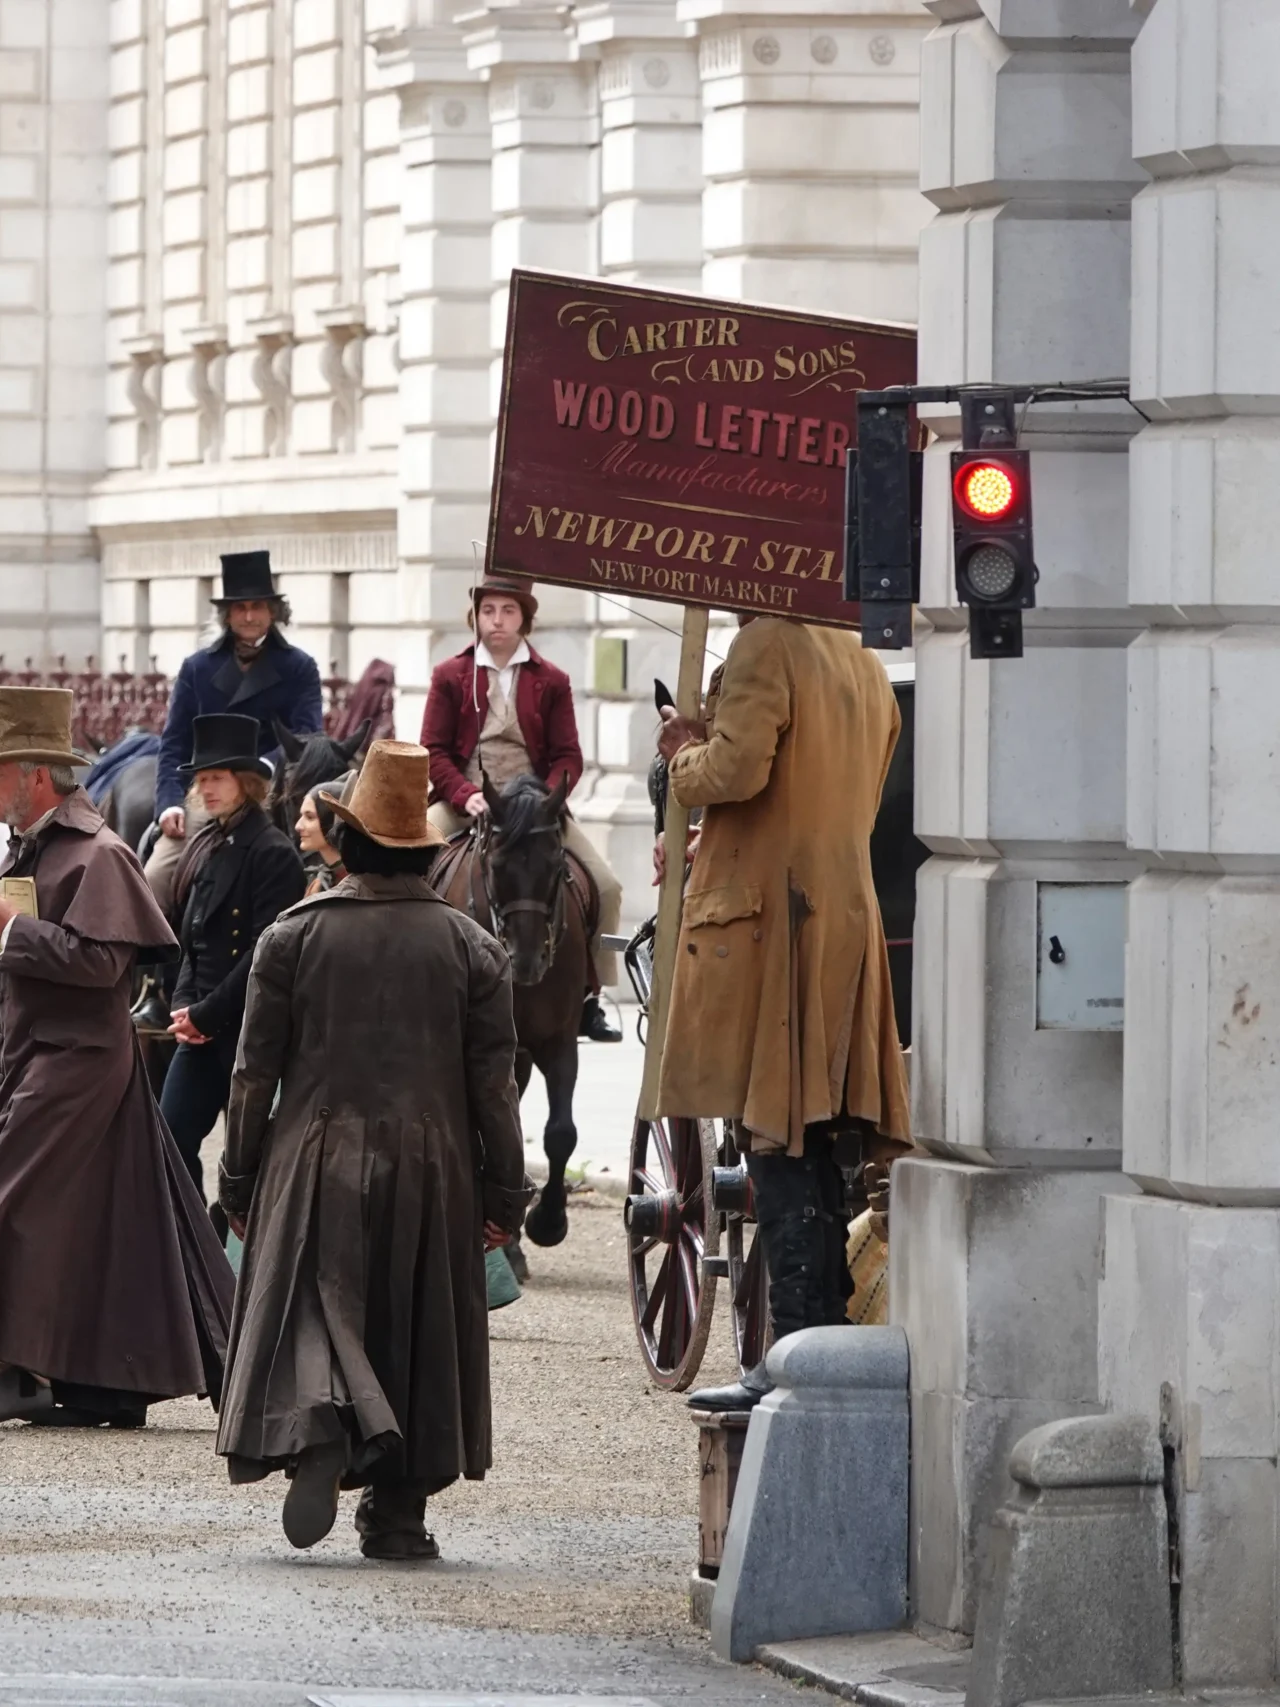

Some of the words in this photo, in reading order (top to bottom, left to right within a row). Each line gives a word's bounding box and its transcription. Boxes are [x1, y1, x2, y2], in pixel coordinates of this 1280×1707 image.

[586, 317, 740, 362] CARTER
[698, 357, 764, 384] AND
[773, 340, 857, 380] SONS
[553, 379, 675, 440] WOOD
[583, 440, 828, 505] Manufacturers
[514, 504, 748, 567] NEWPORT
[753, 540, 844, 583] STA
[589, 558, 700, 593] NEWPORT
[703, 574, 798, 608] MARKET
